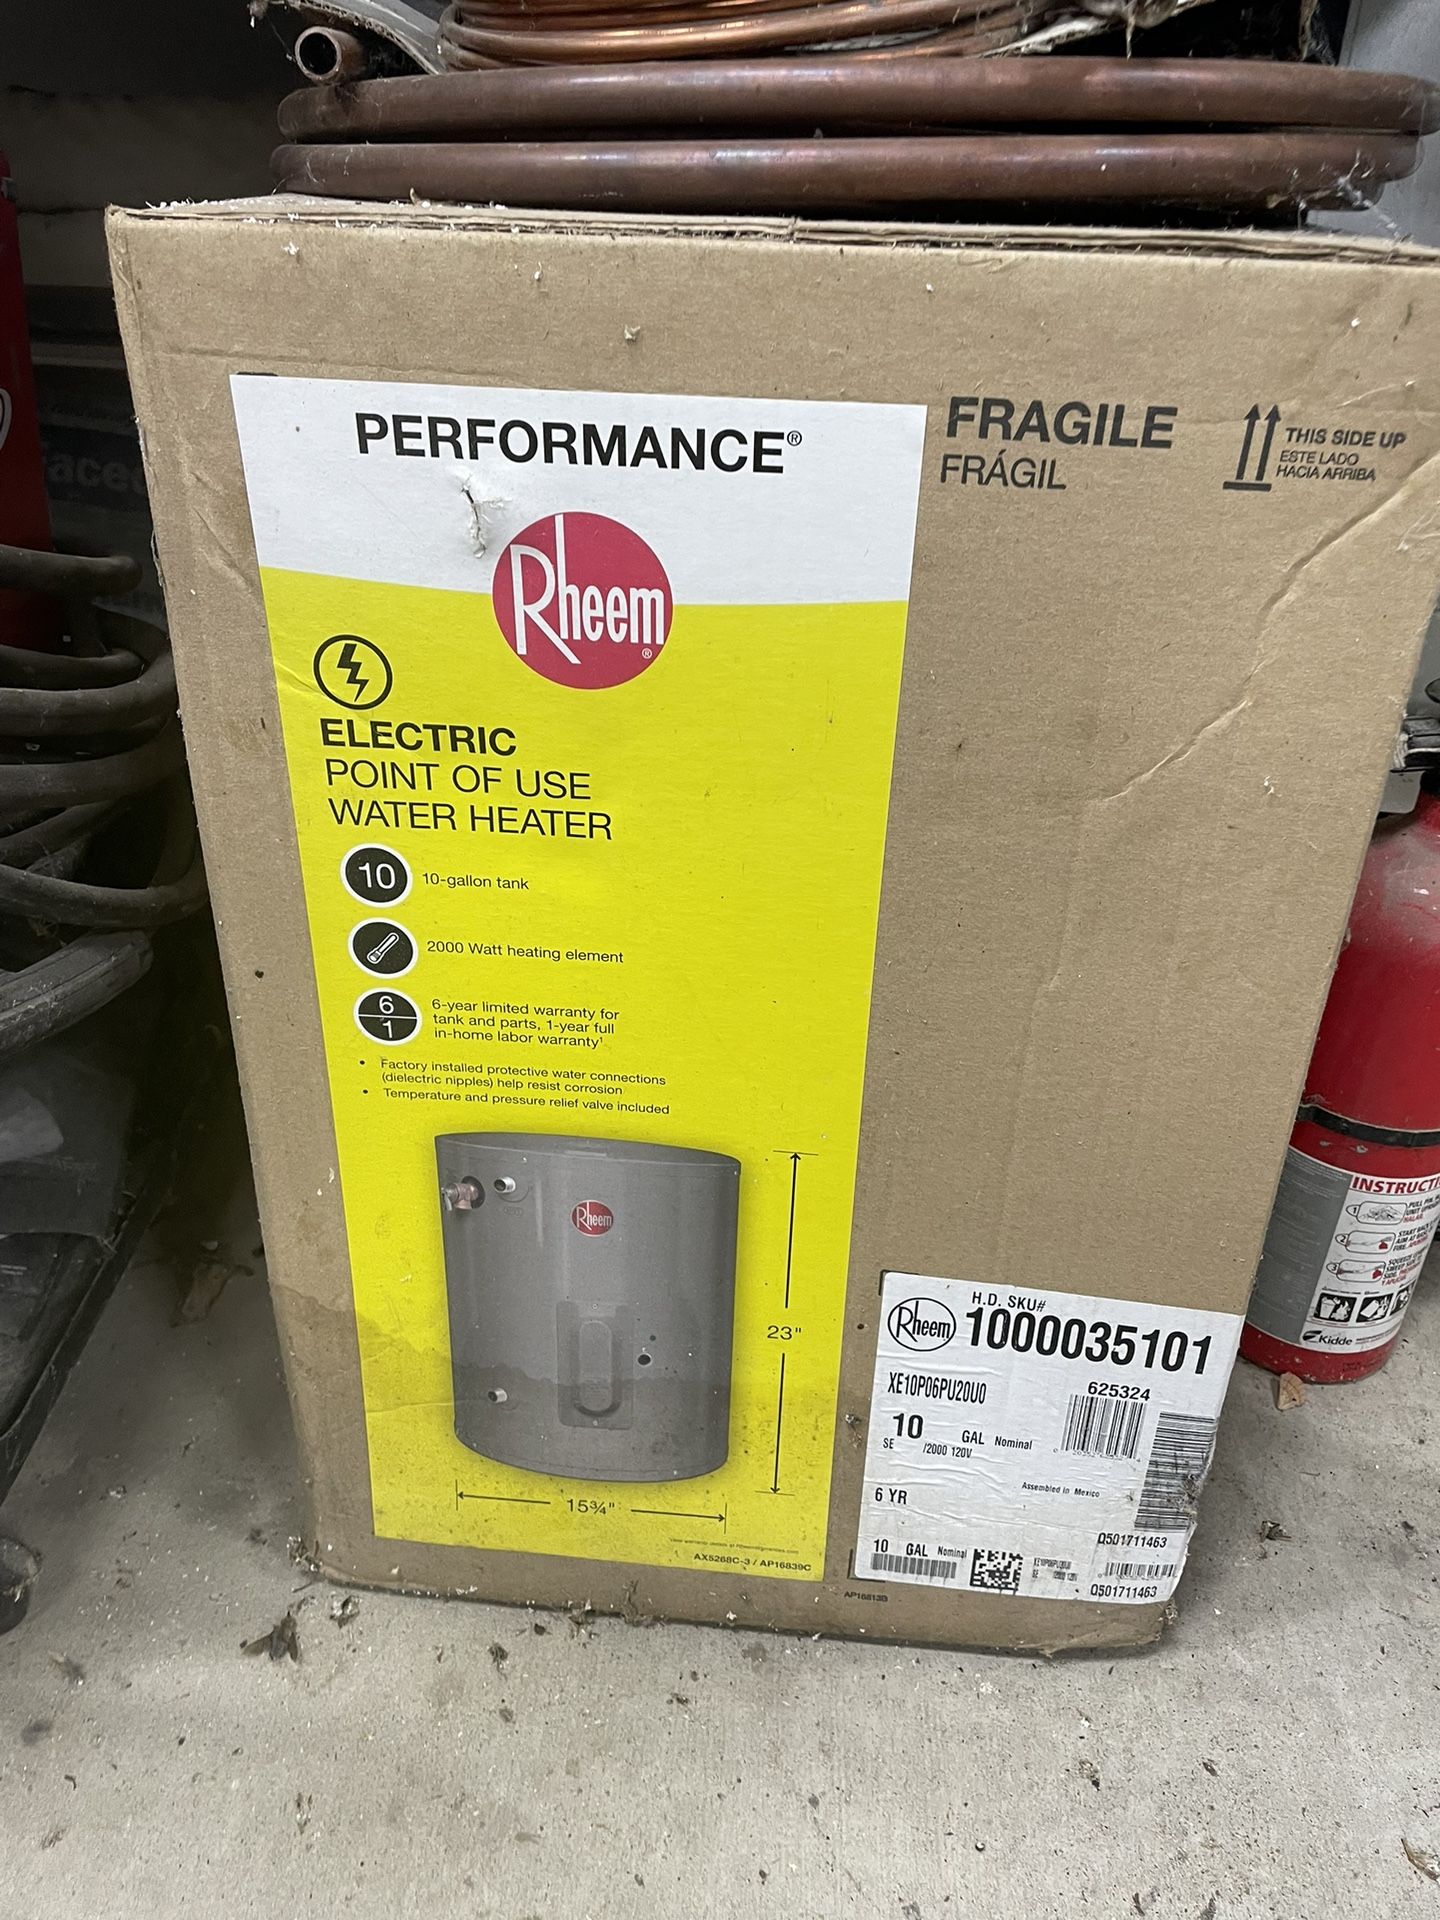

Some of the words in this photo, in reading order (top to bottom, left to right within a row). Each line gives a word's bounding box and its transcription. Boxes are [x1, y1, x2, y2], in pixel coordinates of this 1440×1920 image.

[945, 396, 1178, 449] FRAGILE
[1286, 427, 1327, 444] THIS
[1331, 429, 1376, 446] SIDE
[1379, 432, 1407, 448] UP
[1280, 450, 1317, 463] ESTE
[1319, 452, 1359, 465] LADO
[940, 449, 1067, 490] FRÁGIL
[1276, 465, 1319, 479] HACIA
[1321, 467, 1376, 481] ARRIBA
[508, 513, 664, 664] Rheem
[320, 718, 517, 756] ELECTRIC
[326, 758, 438, 792] POINT
[452, 765, 502, 795] OF
[516, 769, 591, 800] USE
[328, 798, 456, 830] WATER
[470, 807, 612, 840] HEATER
[358, 862, 396, 890] 10
[422, 873, 492, 889] 10-gallon
[497, 876, 529, 890] tank
[427, 940, 464, 955] 2000
[468, 942, 504, 956] Watt
[507, 945, 561, 961] heating
[565, 949, 624, 963] element
[378, 995, 395, 1014] 6
[432, 999, 478, 1012] 6-year
[482, 1001, 529, 1014] limited
[534, 1005, 595, 1020] warranty
[600, 1008, 620, 1020] for
[382, 1020, 393, 1039] 1
[433, 1014, 464, 1025] tank
[469, 1016, 495, 1027] and
[500, 1018, 541, 1031] parts,
[547, 1020, 590, 1033] 1-year
[594, 1022, 614, 1034] full
[434, 1028, 493, 1041] in-home
[498, 1031, 533, 1043] labor
[381, 1058, 428, 1072] Factory
[432, 1061, 483, 1073] installed
[487, 1065, 548, 1077] protective
[552, 1070, 586, 1080] water
[590, 1072, 666, 1085] connections
[382, 1072, 442, 1084] (dielectric
[445, 1075, 493, 1088] nipples)
[497, 1078, 523, 1090] help
[527, 1081, 560, 1091] resist
[564, 1084, 623, 1095] corrosion
[384, 1088, 461, 1100] Temperature
[465, 1093, 488, 1102] and
[492, 1095, 545, 1106] pressure
[550, 1098, 578, 1108] relief
[582, 1100, 613, 1111] valve
[617, 1101, 670, 1114] included
[1352, 1177, 1440, 1195] INSTRUCTI
[576, 1201, 612, 1231] Rheem
[972, 1292, 1002, 1308] H.D.
[1008, 1295, 1046, 1312] SKU#
[896, 1300, 951, 1342] Rheem
[767, 1325, 802, 1341] 23"
[965, 1308, 1212, 1375] 1000035101
[1319, 1335, 1352, 1345] Kidde
[1087, 1381, 1151, 1401] 625324
[893, 1413, 924, 1439] 10
[883, 1437, 894, 1449] SE
[923, 1443, 947, 1456] /2000
[951, 1447, 973, 1459] 120V
[961, 1430, 985, 1445] GAL
[995, 1436, 1033, 1450] Nominal
[875, 1487, 883, 1502] 6
[888, 1488, 908, 1504] YR
[1022, 1481, 1060, 1494] Assembled
[1074, 1488, 1100, 1498] Mexico
[873, 1539, 889, 1553] 10
[906, 1543, 928, 1557] GAL
[937, 1546, 967, 1559] Nominal
[1098, 1532, 1167, 1549] Q501711463
[1090, 1583, 1157, 1598] Q501711463
